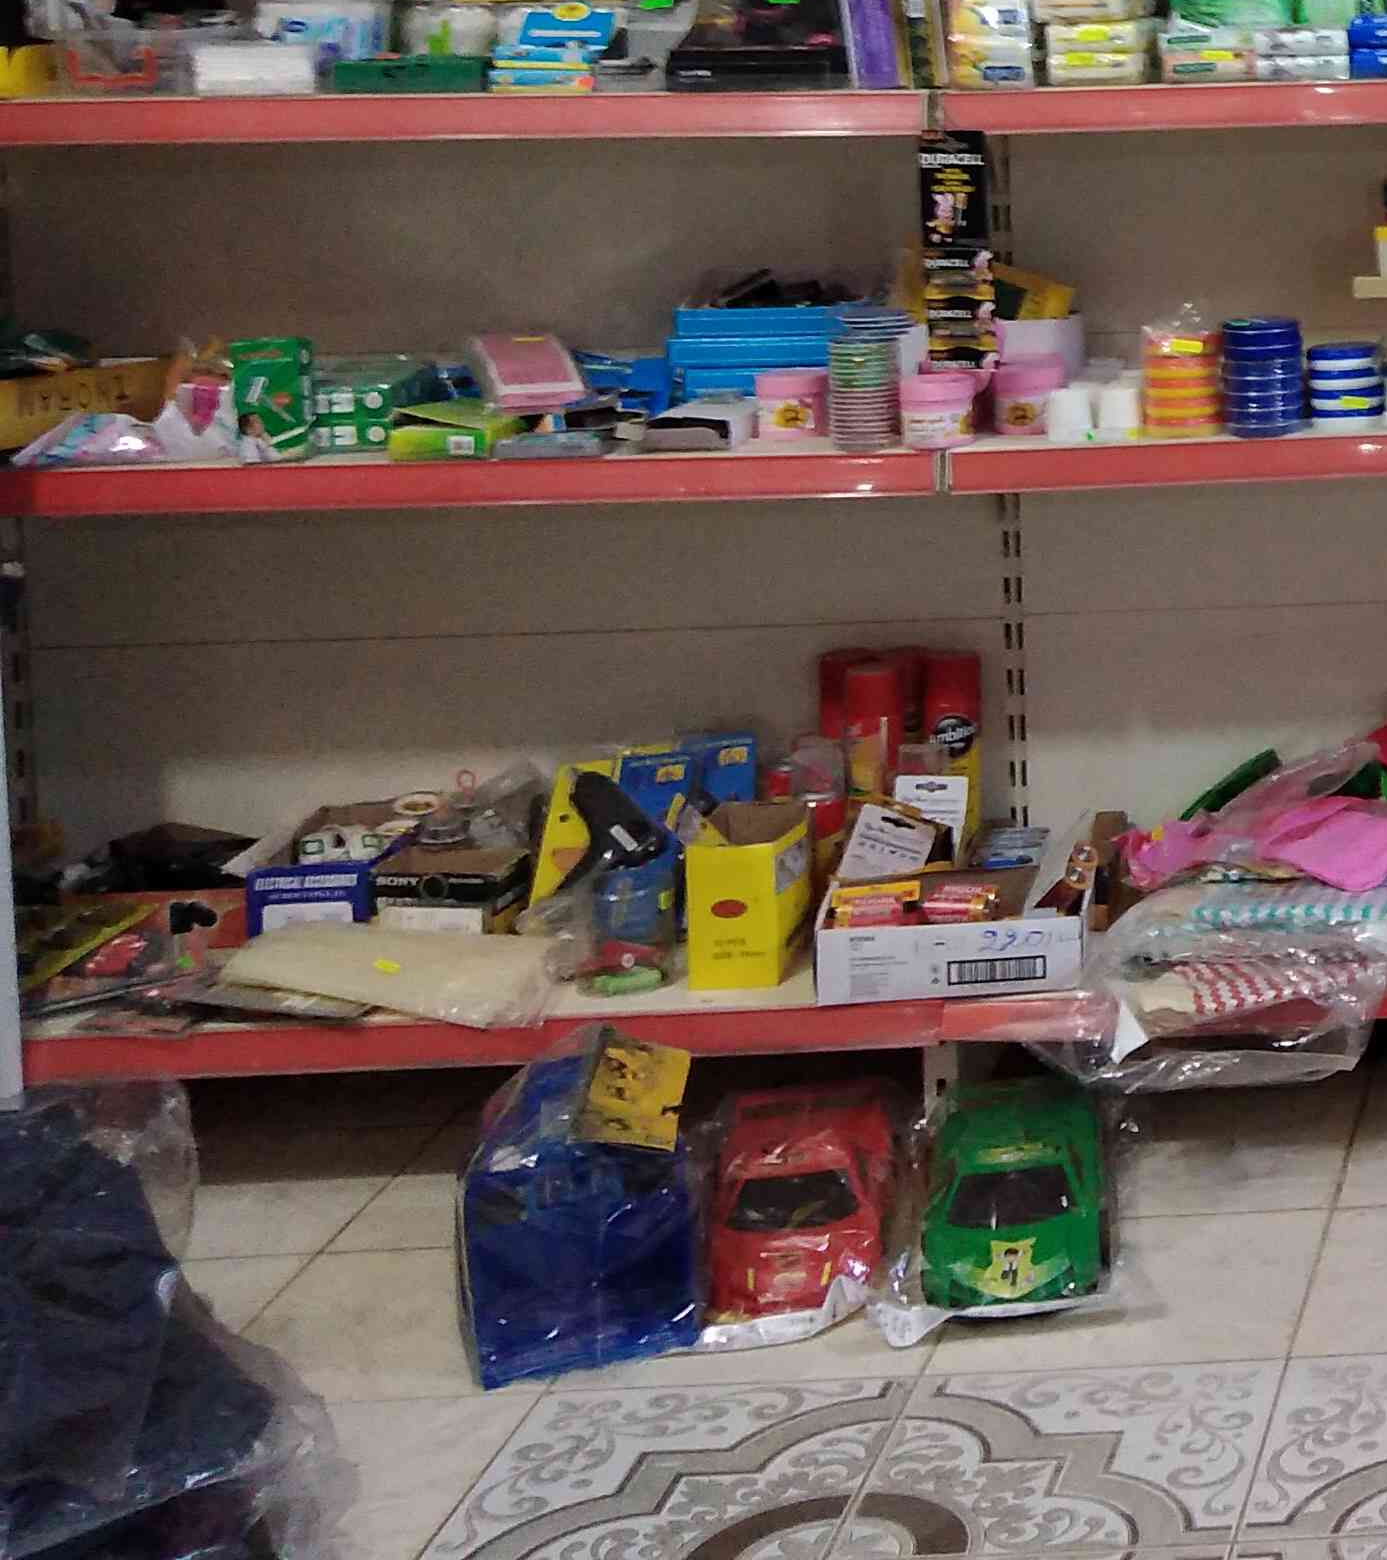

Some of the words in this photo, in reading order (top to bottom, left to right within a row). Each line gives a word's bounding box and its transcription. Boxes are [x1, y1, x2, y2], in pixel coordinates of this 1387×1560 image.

[919, 152, 985, 165] DURACELL
[928, 309, 973, 319] DURACELL
[375, 875, 419, 887] SONY
